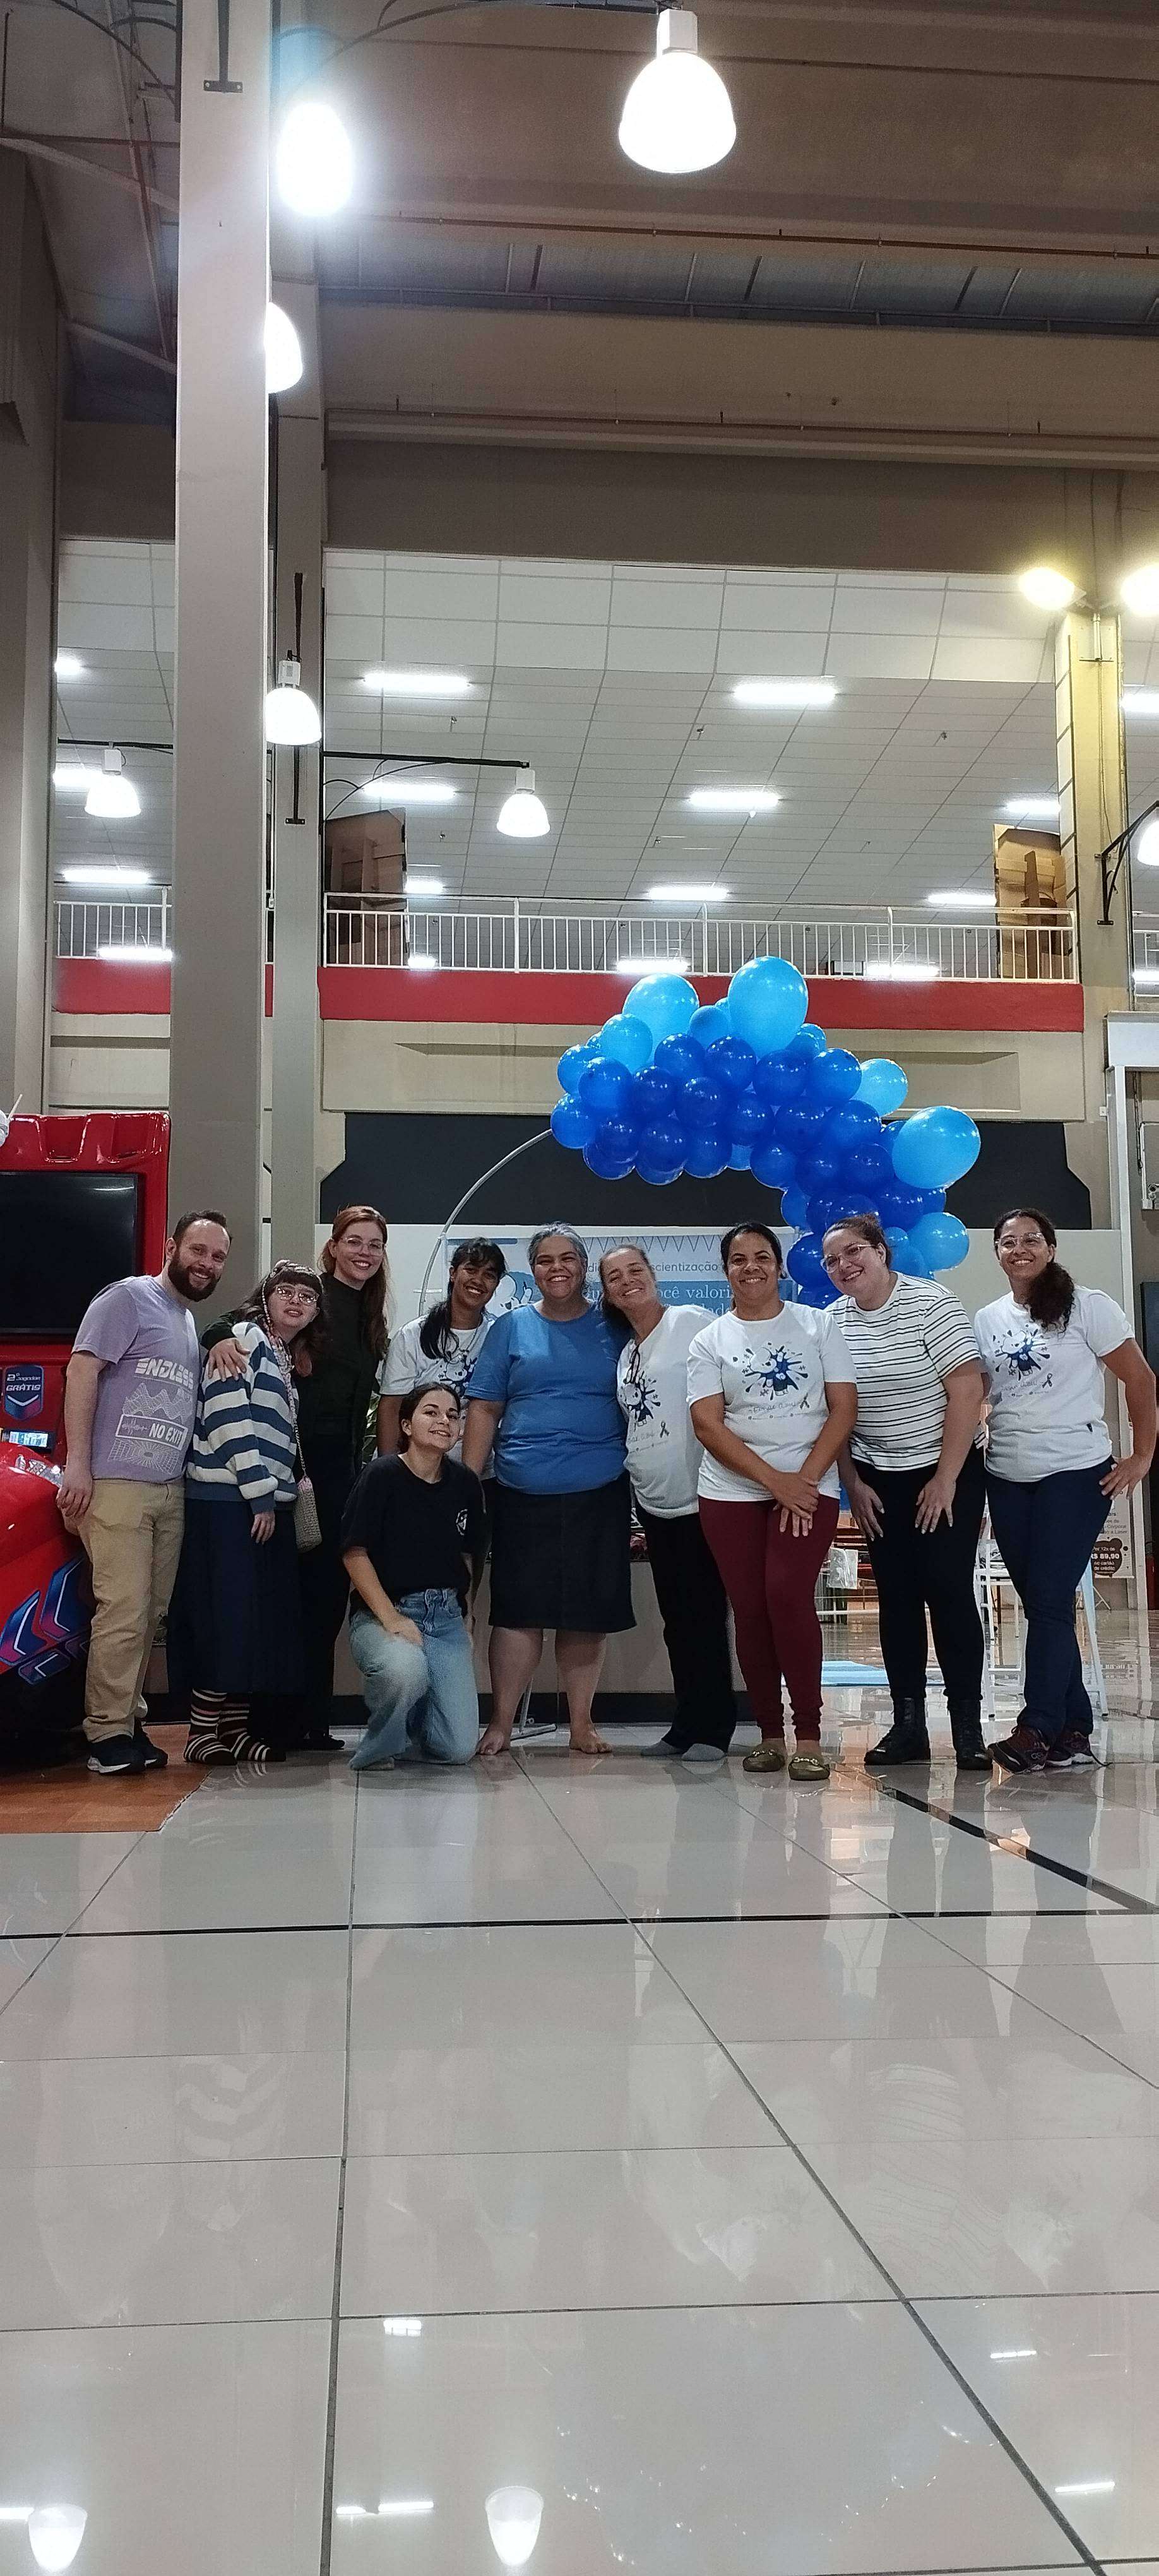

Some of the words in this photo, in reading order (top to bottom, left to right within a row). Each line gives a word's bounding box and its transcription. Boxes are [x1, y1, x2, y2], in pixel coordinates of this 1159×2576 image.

[652, 1261, 719, 1273] scientização
[687, 1284, 730, 1299] valori
[134, 1357, 194, 1390] ENDLESS
[6, 1383, 41, 1392] GRÁTIS
[149, 1422, 165, 1439] NO
[165, 1427, 184, 1445] EXIT
